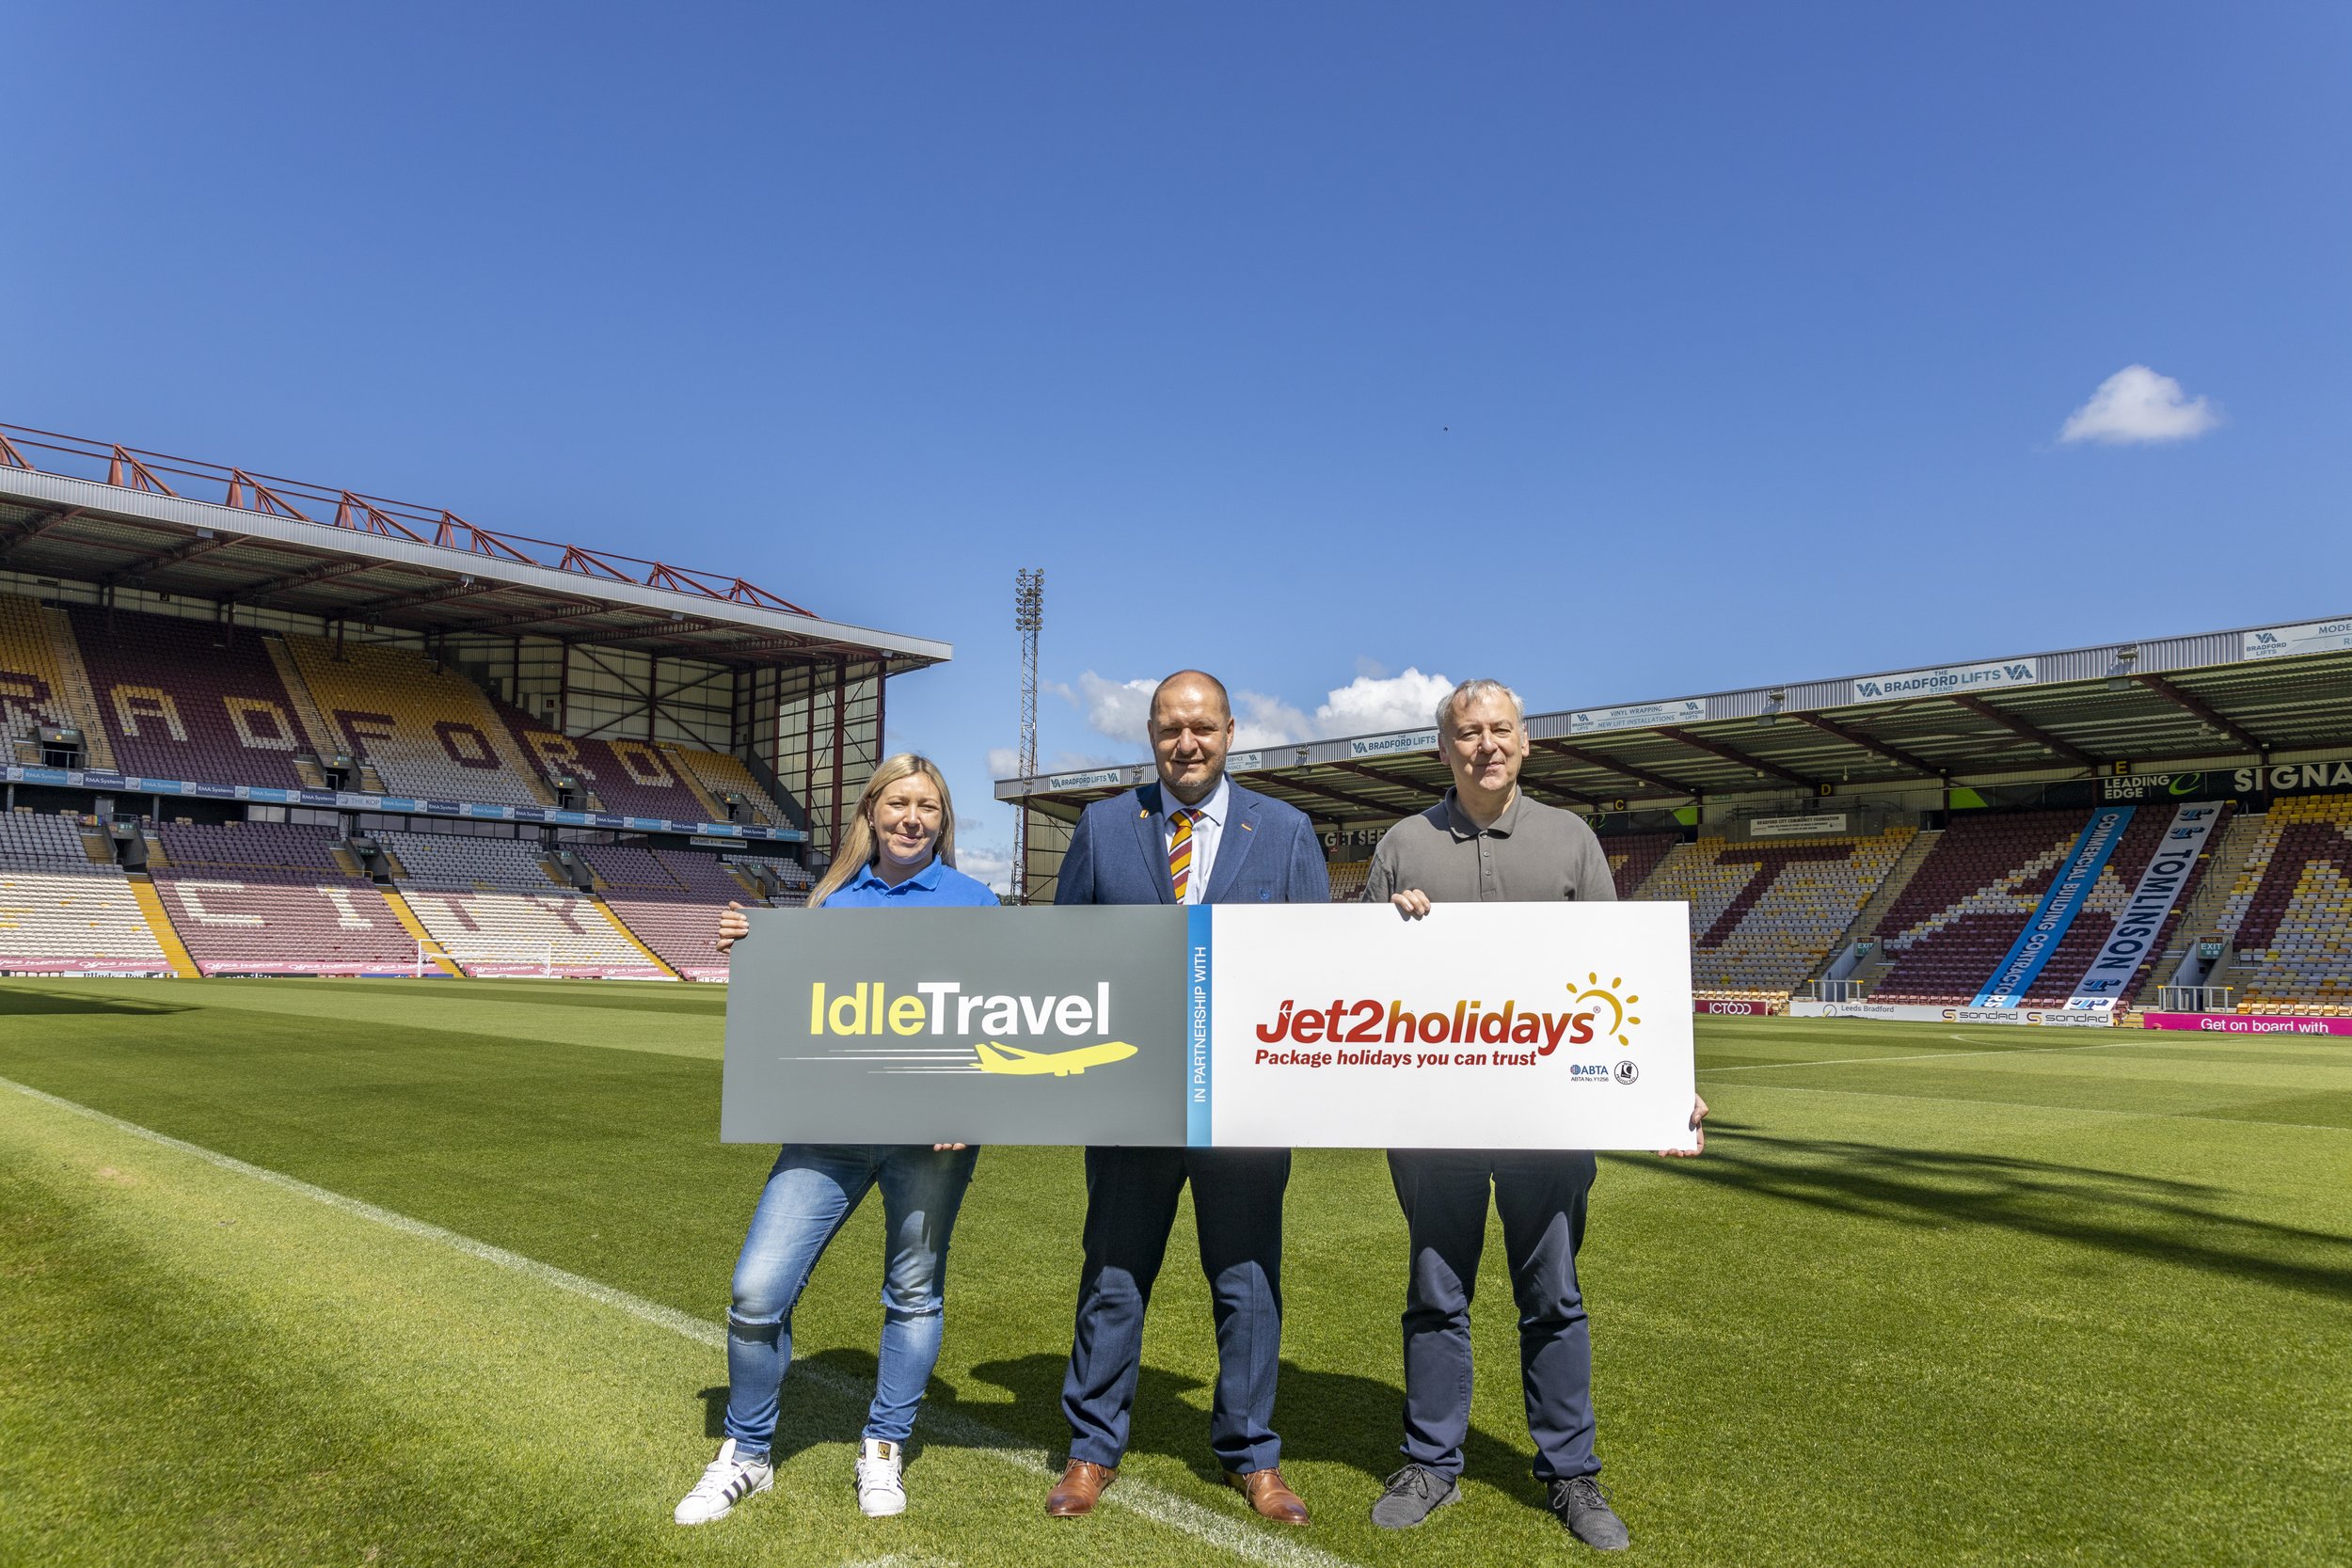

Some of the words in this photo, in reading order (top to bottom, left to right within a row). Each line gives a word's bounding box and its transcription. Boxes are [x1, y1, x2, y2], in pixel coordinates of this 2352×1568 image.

[2247, 642, 2287, 652] BRADFORD
[1884, 675, 1958, 692] BRADFORD
[1961, 670, 2001, 684] LIFTS
[1629, 705, 1662, 715] WRAPPING
[1627, 715, 1675, 725] INSTALLATIONS
[1369, 738, 1411, 750] BRADFORD
[1413, 736, 1436, 745] LIFTS
[2116, 761, 2127, 774] E
[1061, 777, 1090, 786] BRADFORD
[1091, 775, 1106, 784] LIFTS
[2105, 775, 2170, 789] LEADING
[1821, 784, 1831, 796] D
[2105, 787, 2143, 800] EDGE
[1615, 800, 1624, 810] C
[2067, 814, 2121, 881] COMMERCIAL
[2035, 882, 2082, 931] BUILDING
[2096, 849, 2193, 969] TOMLINSON
[1194, 946, 1206, 983] WITH
[1984, 933, 2050, 1008] CONTRACTORS
[2201, 1018, 2226, 1031] Get
[2230, 1021, 2248, 1031] on
[2252, 1020, 2294, 1032] board
[2298, 1022, 2328, 1033] with
[1194, 986, 1206, 1085] PARTNERSHIP
[1255, 1049, 1332, 1068] Package
[1336, 1049, 1412, 1069] holidays
[1416, 1053, 1451, 1068] you
[1454, 1053, 1489, 1066] can
[1492, 1051, 1536, 1066] trust
[1581, 1066, 1609, 1074] ABTA
[1194, 1088, 1206, 1102] IN
